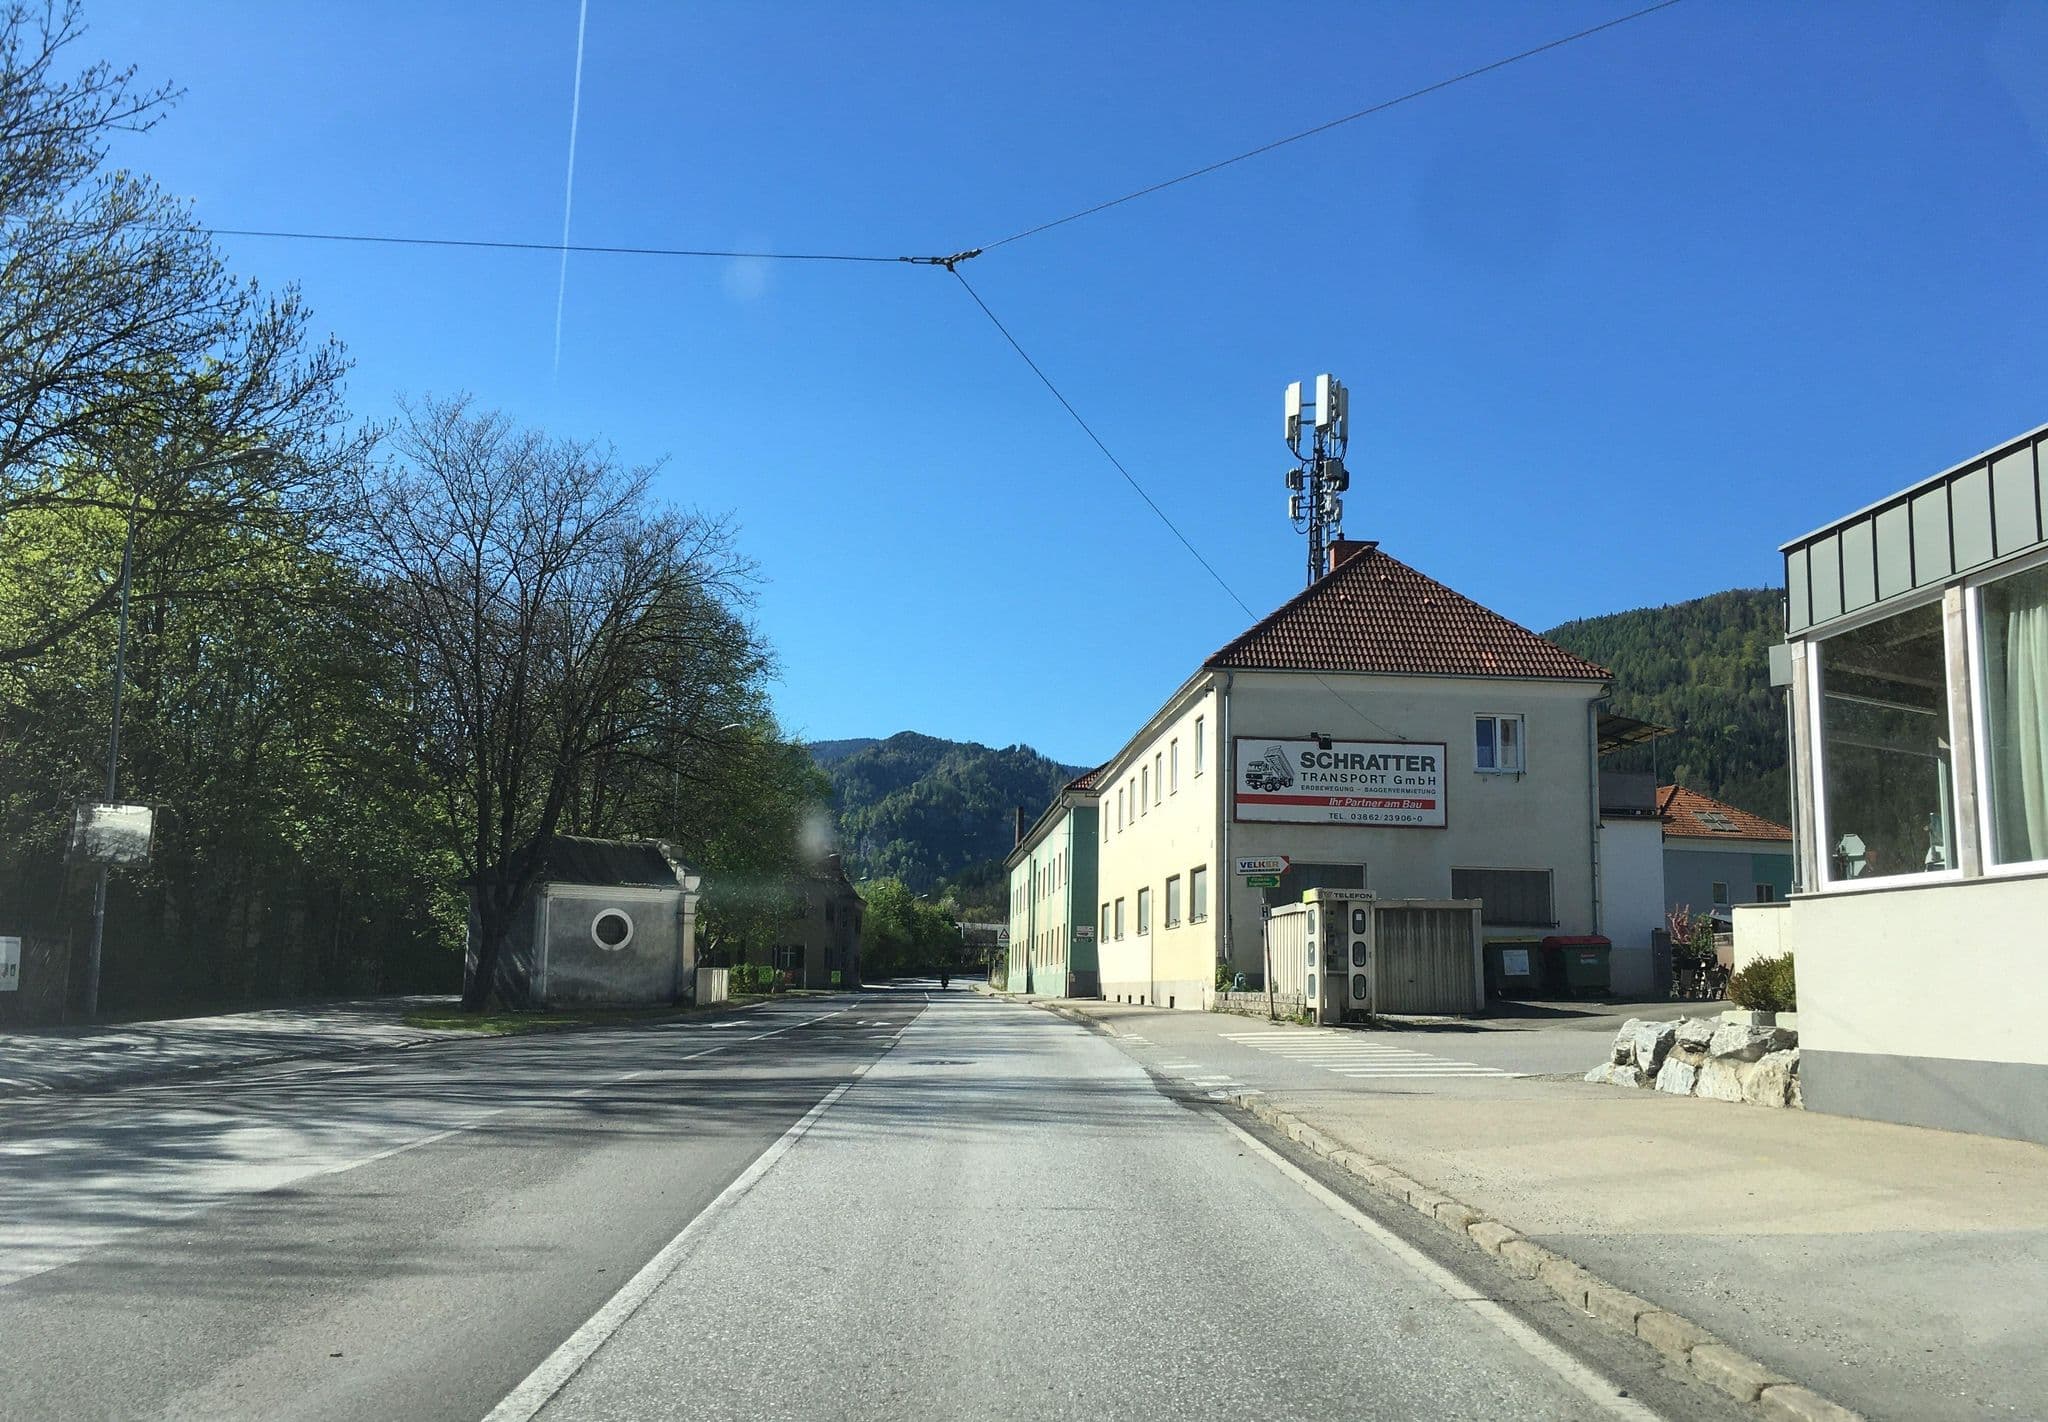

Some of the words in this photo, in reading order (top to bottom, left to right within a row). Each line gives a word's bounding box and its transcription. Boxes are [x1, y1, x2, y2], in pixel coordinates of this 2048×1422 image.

[1301, 752, 1435, 772] SCHRATTER
[1301, 772, 1386, 784] TRANSPORT
[1394, 775, 1436, 786] GmbH
[1364, 787, 1436, 795] BAGGERVERMIETUNG
[1329, 797, 1342, 806] Ihr
[1345, 798, 1384, 807] Partner
[1384, 800, 1400, 808] am
[1402, 800, 1422, 809] Bau
[1350, 813, 1423, 822] 03862/23906-0
[1261, 906, 1269, 917] H
